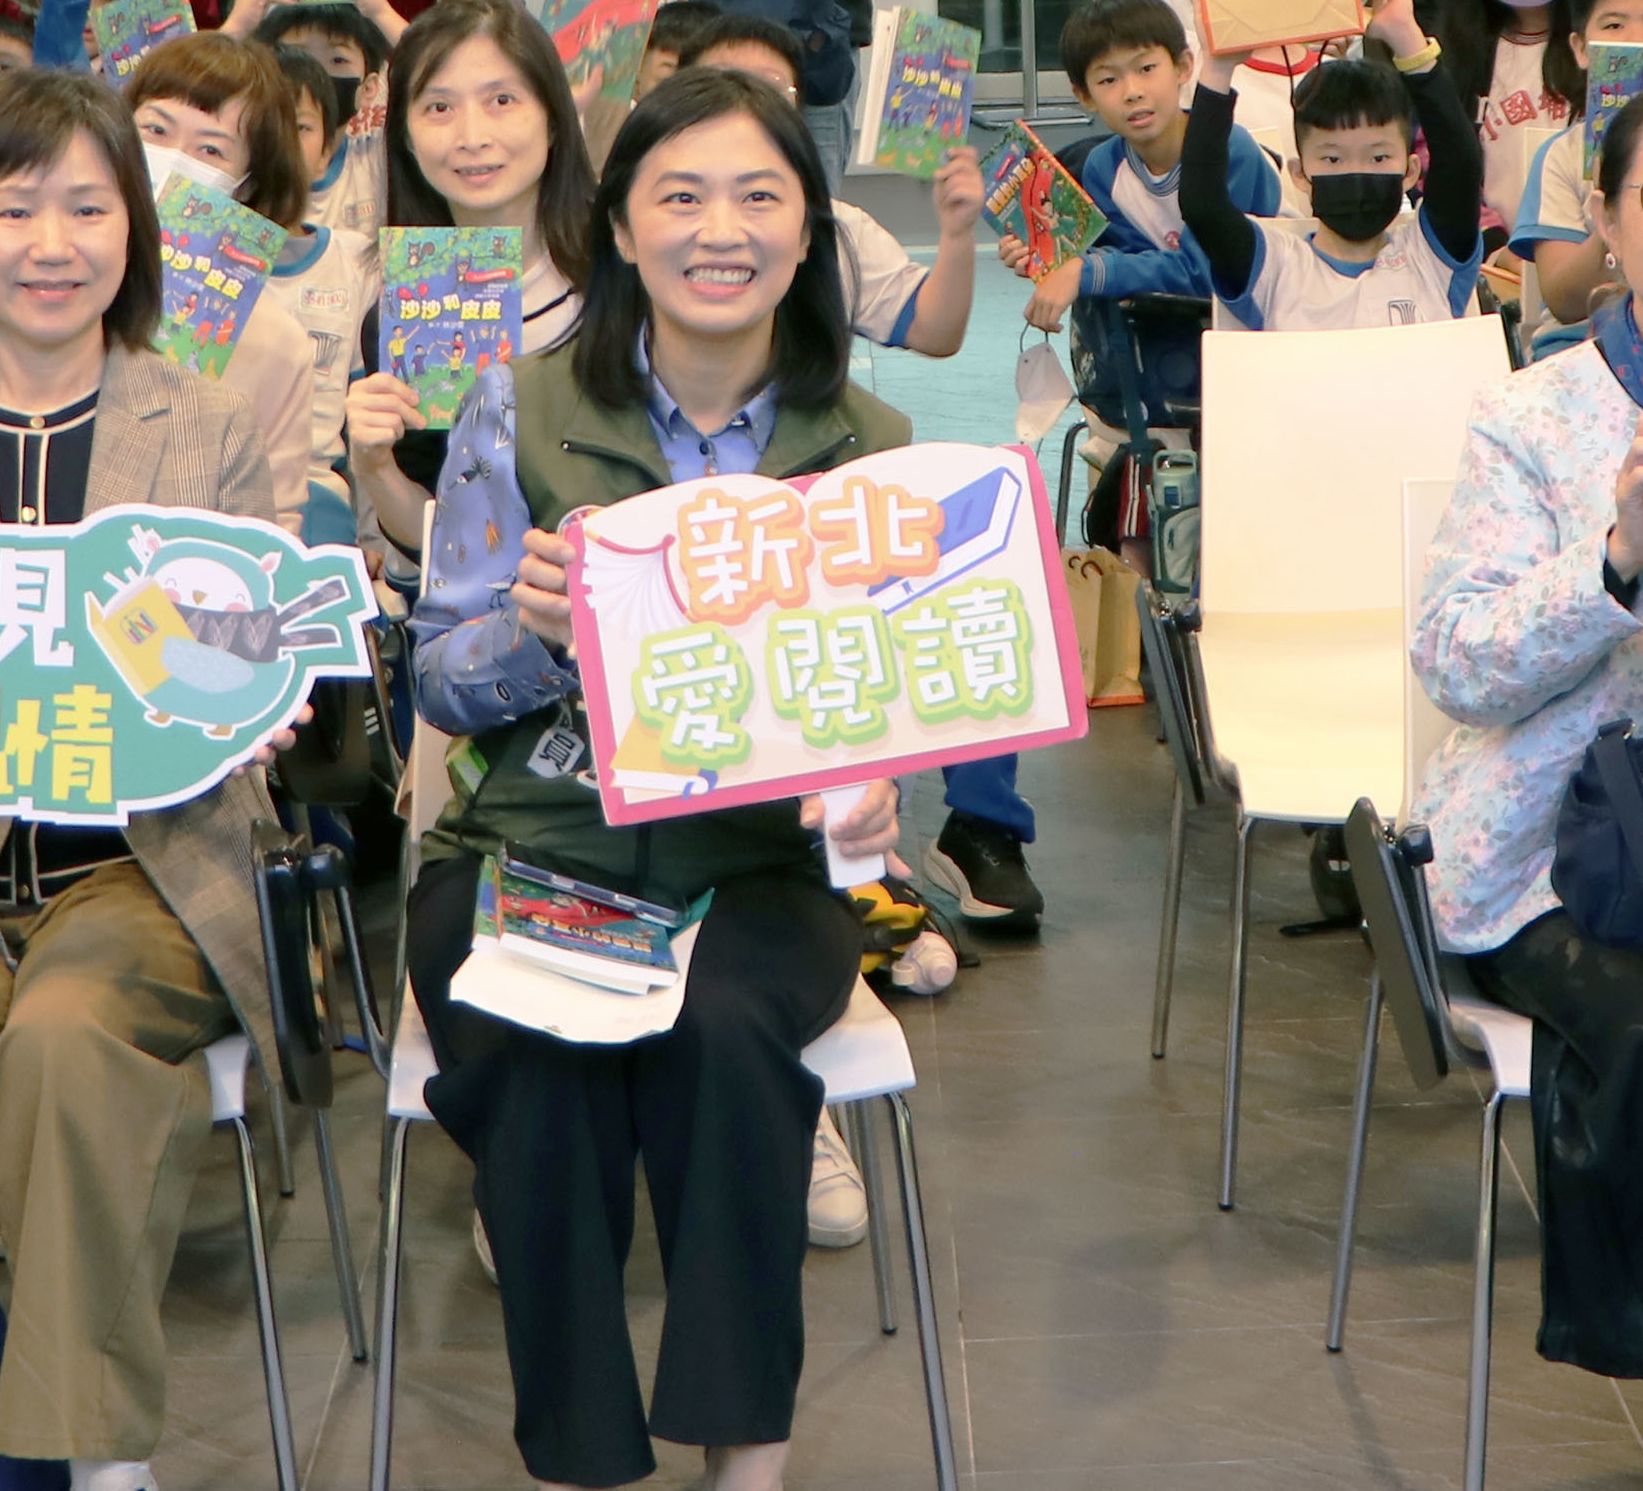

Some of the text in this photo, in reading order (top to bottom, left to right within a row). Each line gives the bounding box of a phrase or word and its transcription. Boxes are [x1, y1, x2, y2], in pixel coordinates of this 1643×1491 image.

[399, 291, 502, 321] 沙沙和皮皮
[684, 481, 931, 608] 新北
[639, 586, 1020, 754] 愛閱讀
